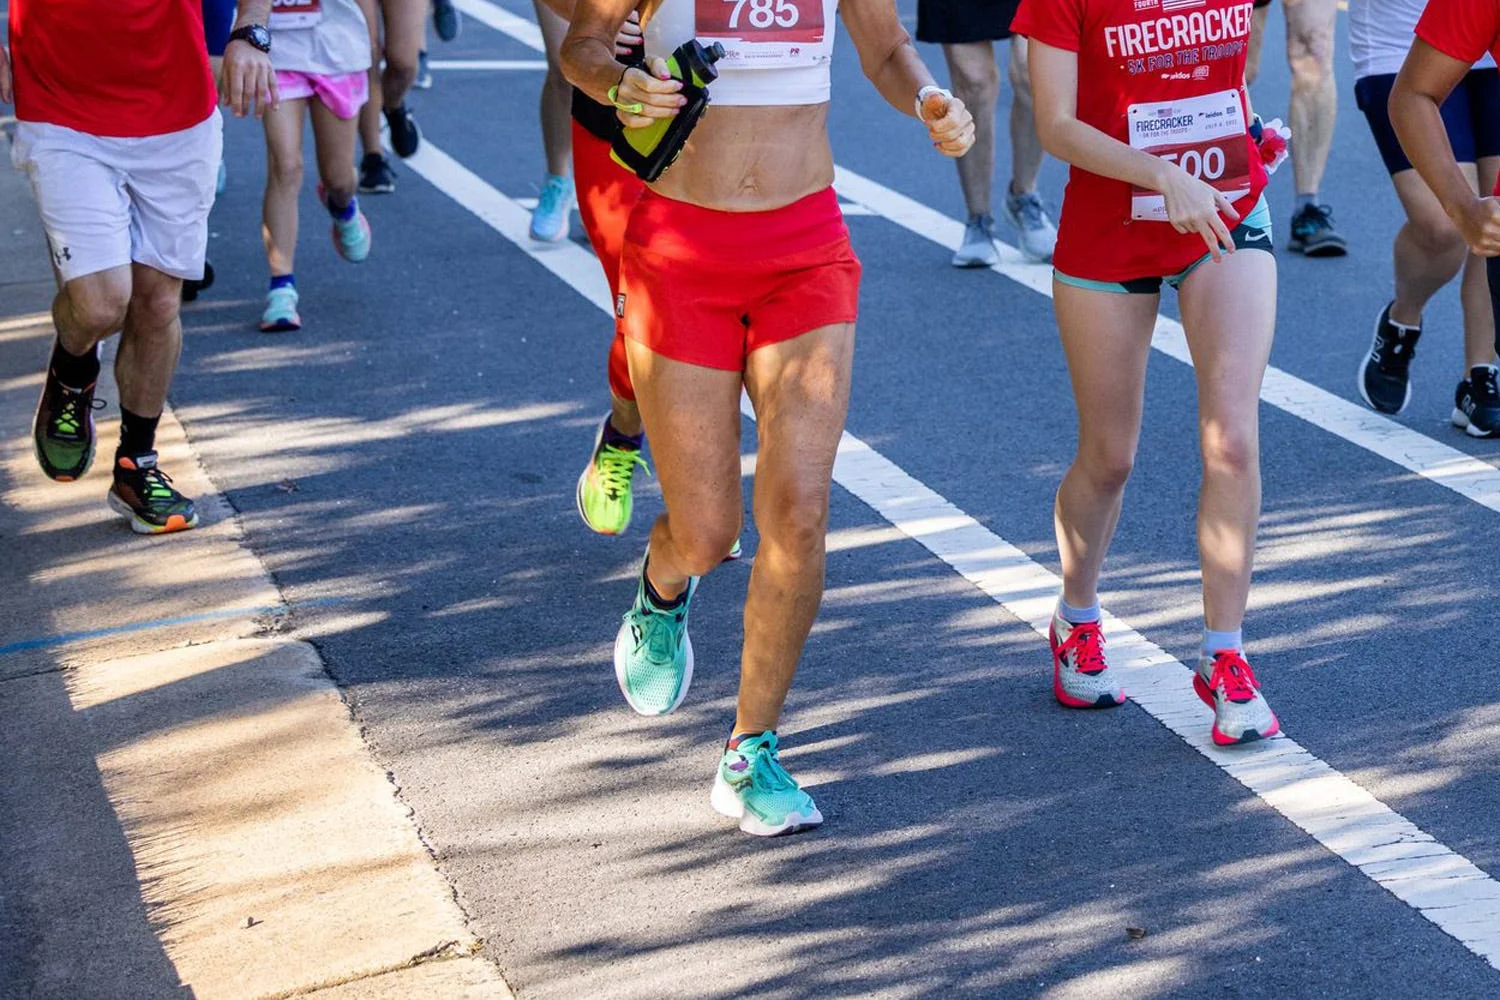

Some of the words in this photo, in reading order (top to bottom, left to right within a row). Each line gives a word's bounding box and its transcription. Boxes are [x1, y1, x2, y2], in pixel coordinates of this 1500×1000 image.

[1134, 0, 1159, 9] FOURTH
[1104, 3, 1253, 57] FIRECRACKER
[1128, 59, 1145, 75] 5K
[1148, 54, 1174, 70] FOR
[1177, 48, 1199, 65] THE
[1170, 70, 1190, 80] leidos
[1136, 115, 1193, 132] FIRECRACKER
[1159, 147, 1225, 180] 00
